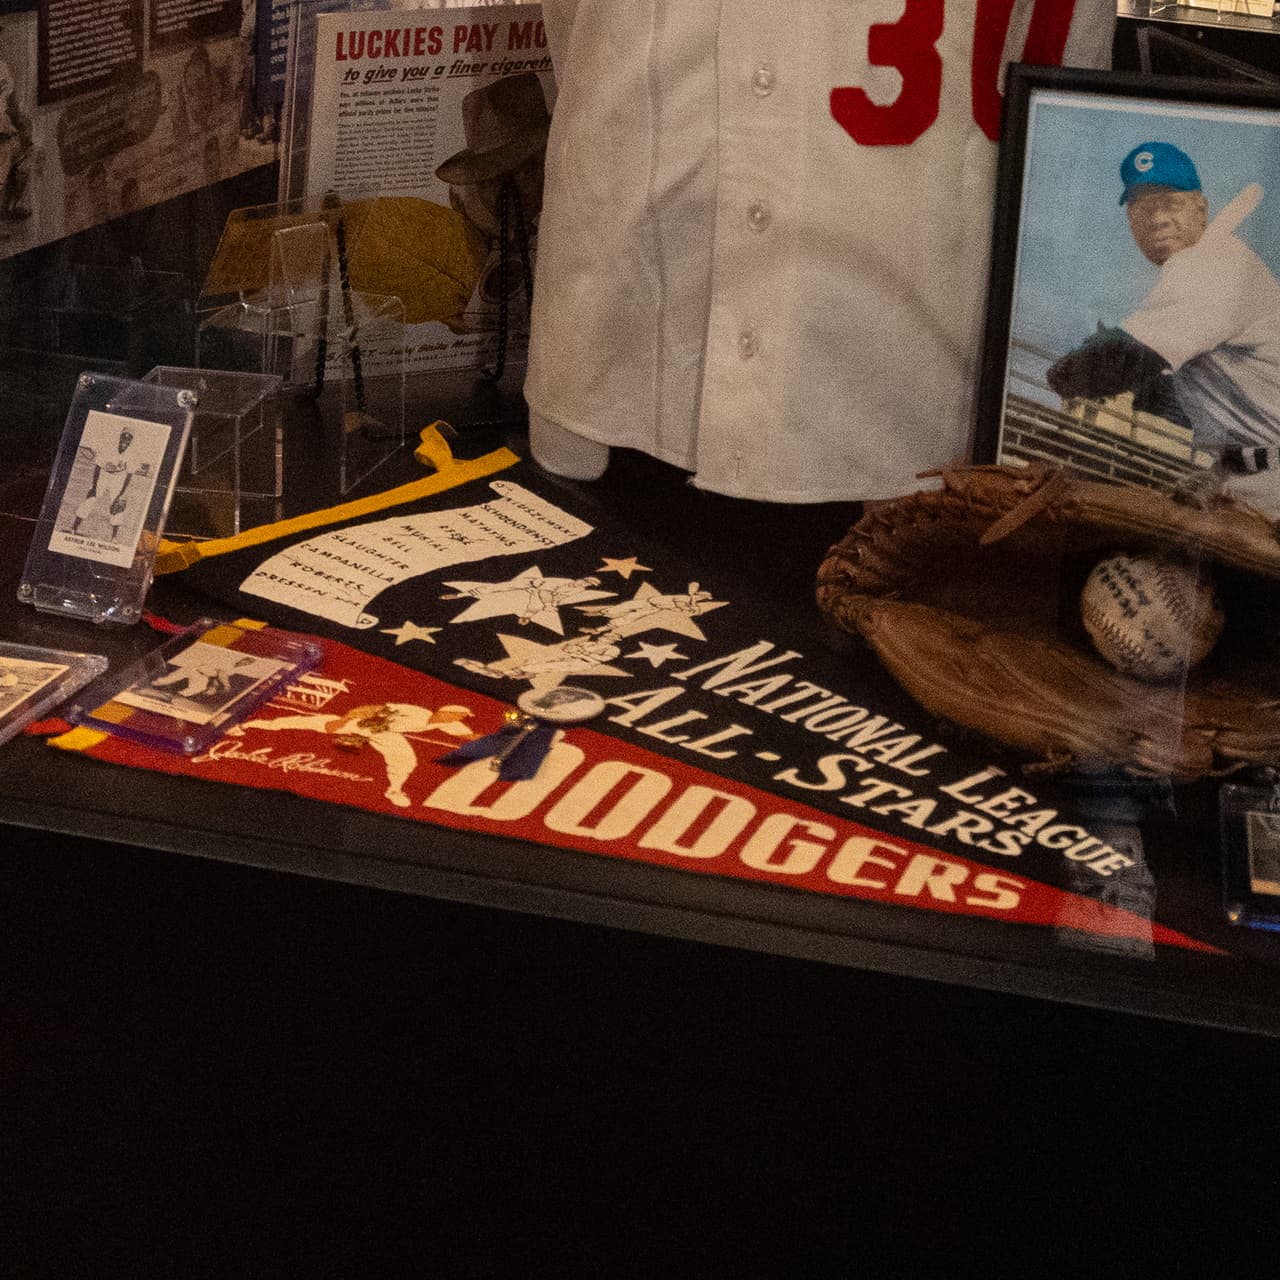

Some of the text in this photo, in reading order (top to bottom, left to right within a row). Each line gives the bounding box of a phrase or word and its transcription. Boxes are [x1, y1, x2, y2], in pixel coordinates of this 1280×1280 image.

[335, 25, 443, 61] LUCKIES
[452, 22, 496, 54] PAY
[341, 68, 361, 82] to
[364, 67, 398, 84] give
[401, 64, 430, 82] you
[433, 65, 444, 76] a
[448, 60, 488, 75] finer
[1131, 150, 1154, 173] C
[299, 542, 395, 583] CAMPANELLA
[331, 533, 410, 570] SLAUGHTER
[669, 639, 1135, 878] NATIONAL LEAGUE
[422, 730, 1027, 912] DODGERS
